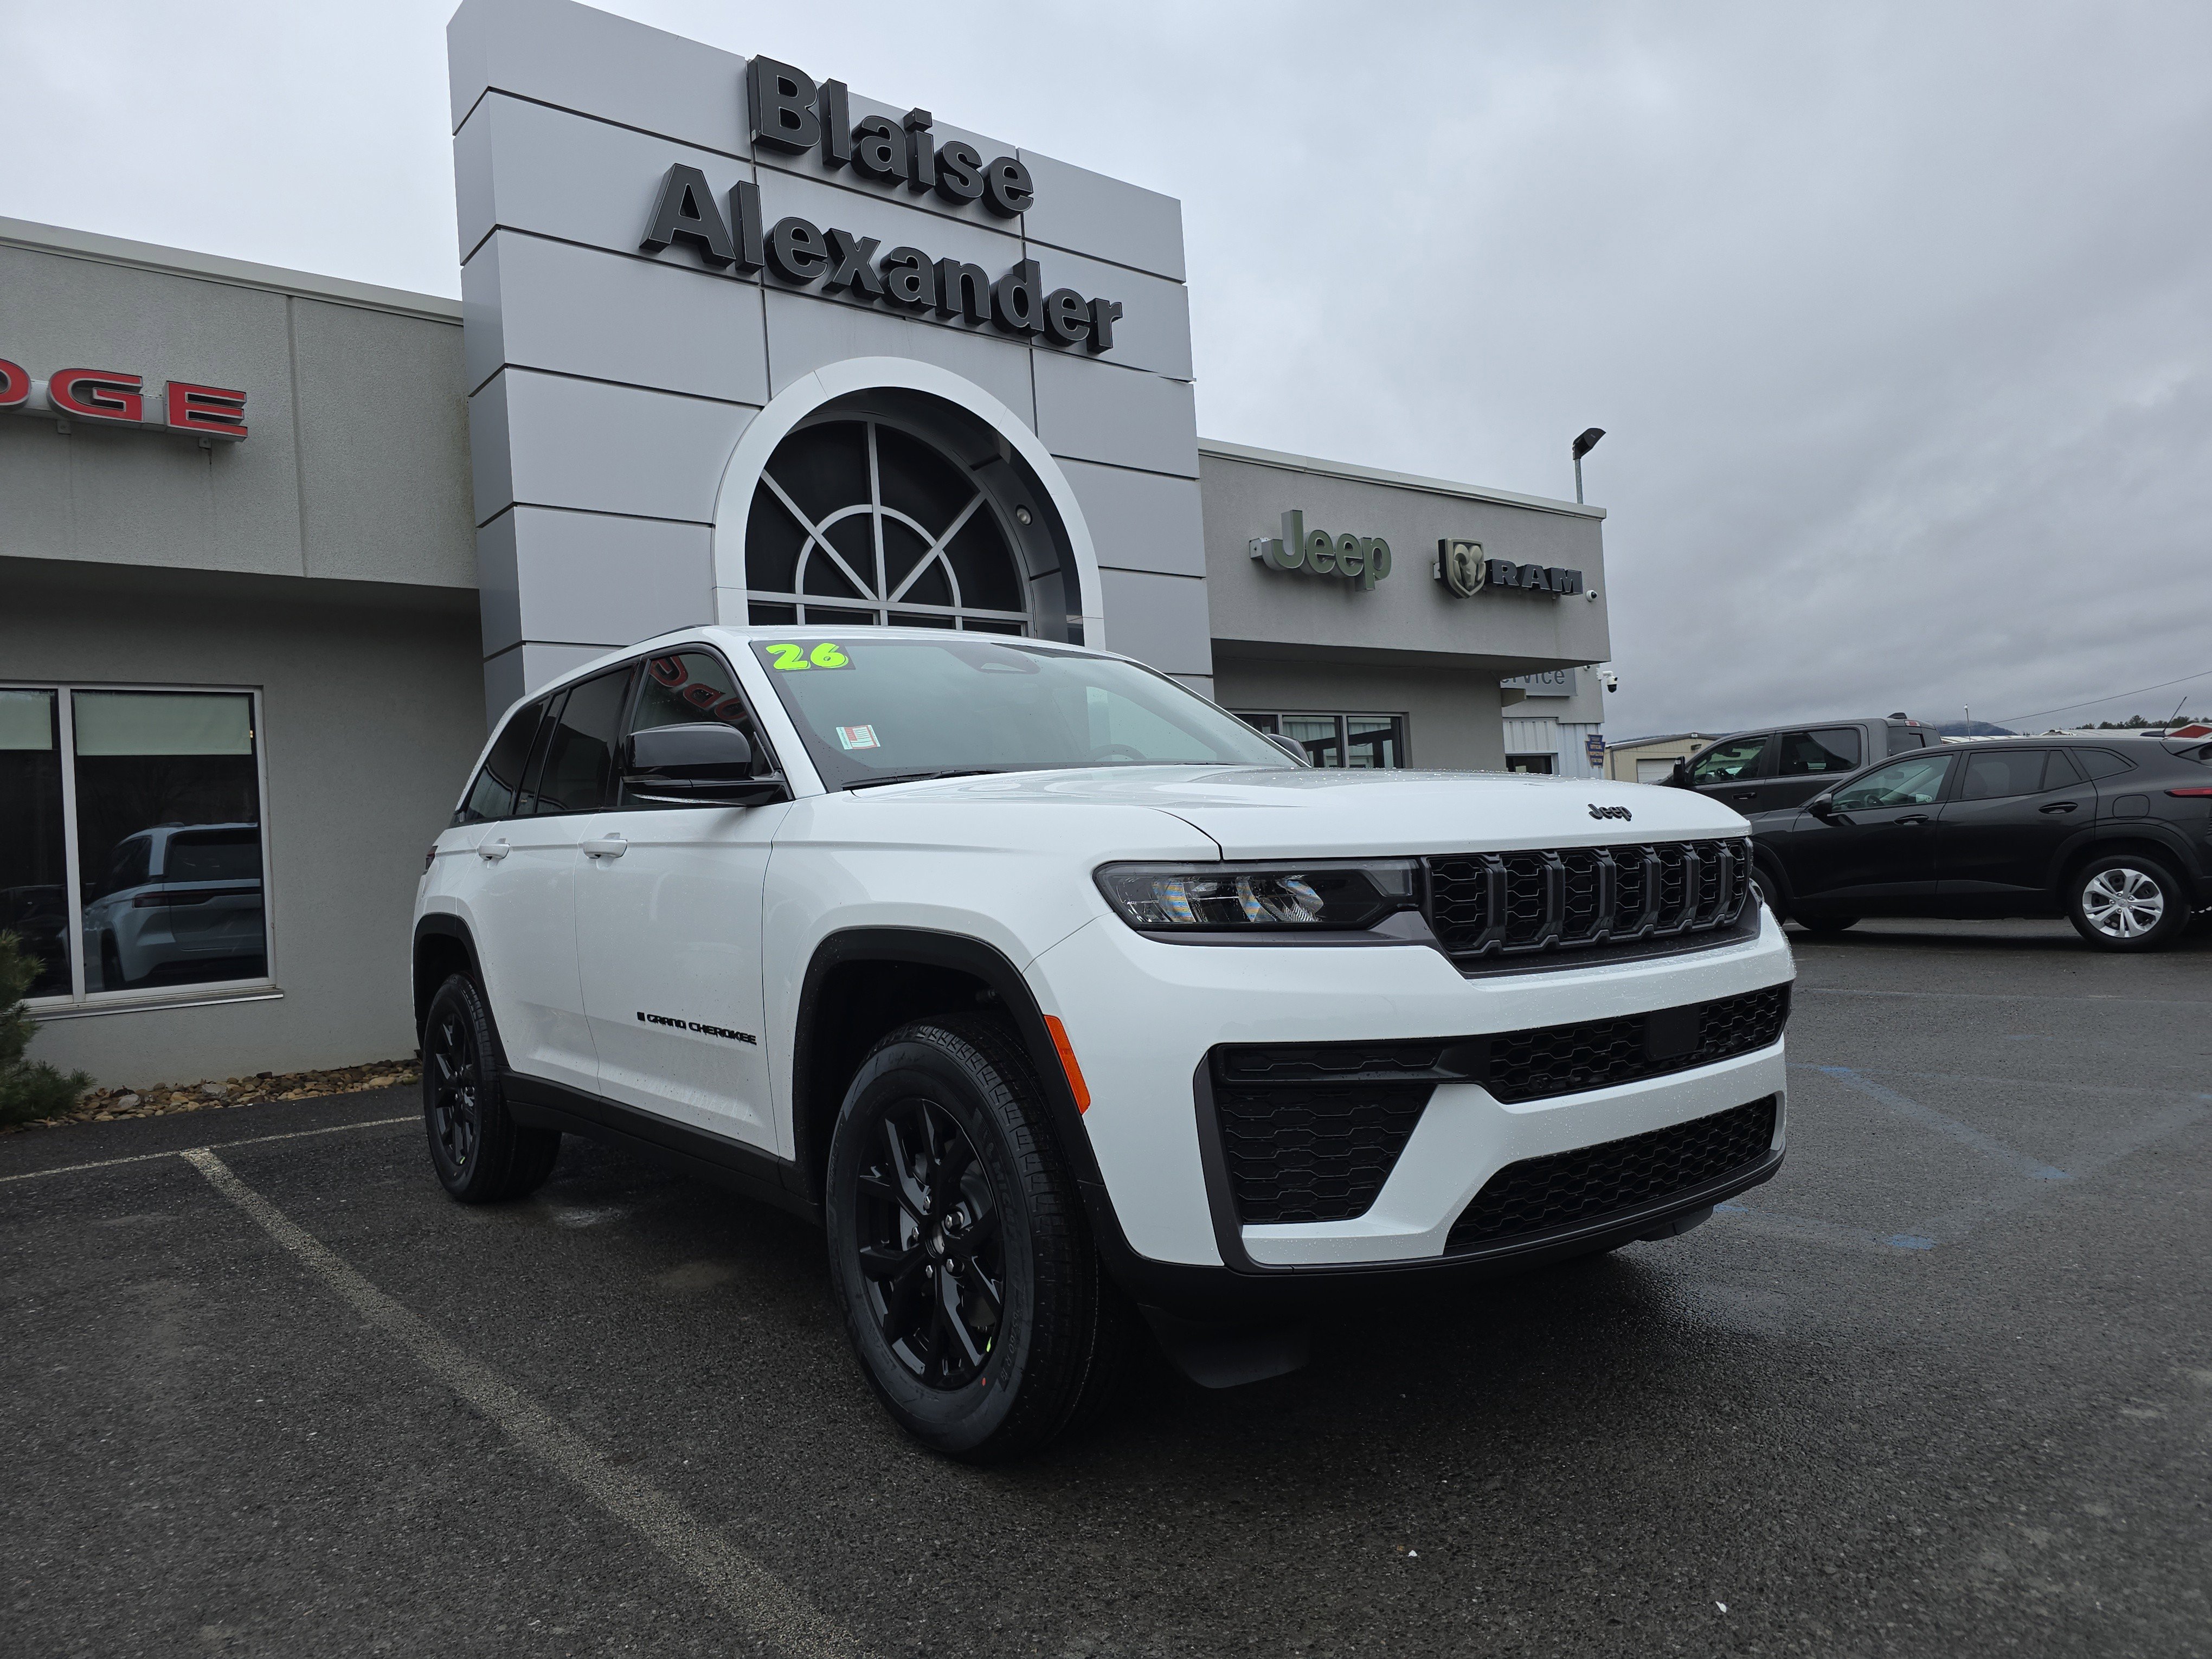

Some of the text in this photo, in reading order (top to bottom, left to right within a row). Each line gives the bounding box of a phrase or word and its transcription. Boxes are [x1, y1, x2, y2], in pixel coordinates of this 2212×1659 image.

[747, 54, 1034, 218] Blaise
[639, 163, 1123, 355] Alexander
[1262, 509, 1392, 590] Jeep
[1486, 558, 1583, 596] RAM
[766, 642, 849, 670] 26
[1587, 803, 1632, 821] Jeep
[647, 1014, 757, 1045] GRAND CHEROKEE
